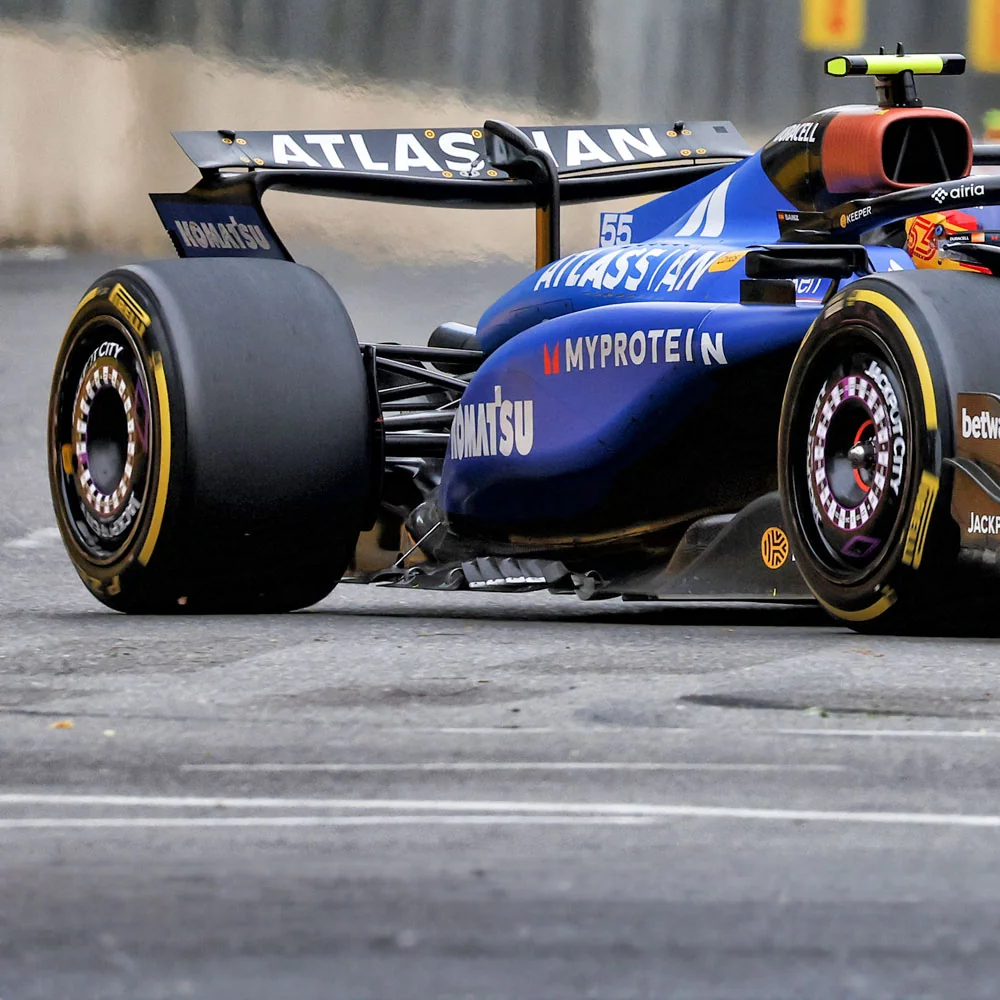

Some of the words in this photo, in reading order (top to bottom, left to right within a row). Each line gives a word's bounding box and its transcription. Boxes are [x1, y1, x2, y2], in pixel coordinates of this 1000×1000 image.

[272, 128, 668, 173] ATLASIAN
[950, 183, 985, 200] airia
[601, 213, 634, 247] 55
[846, 205, 872, 224] KEEPER
[174, 215, 271, 250] KOMATSU
[534, 248, 726, 291] ATLASSIAN
[98, 341, 124, 359] CITY
[566, 328, 728, 372] MYPROTEIN
